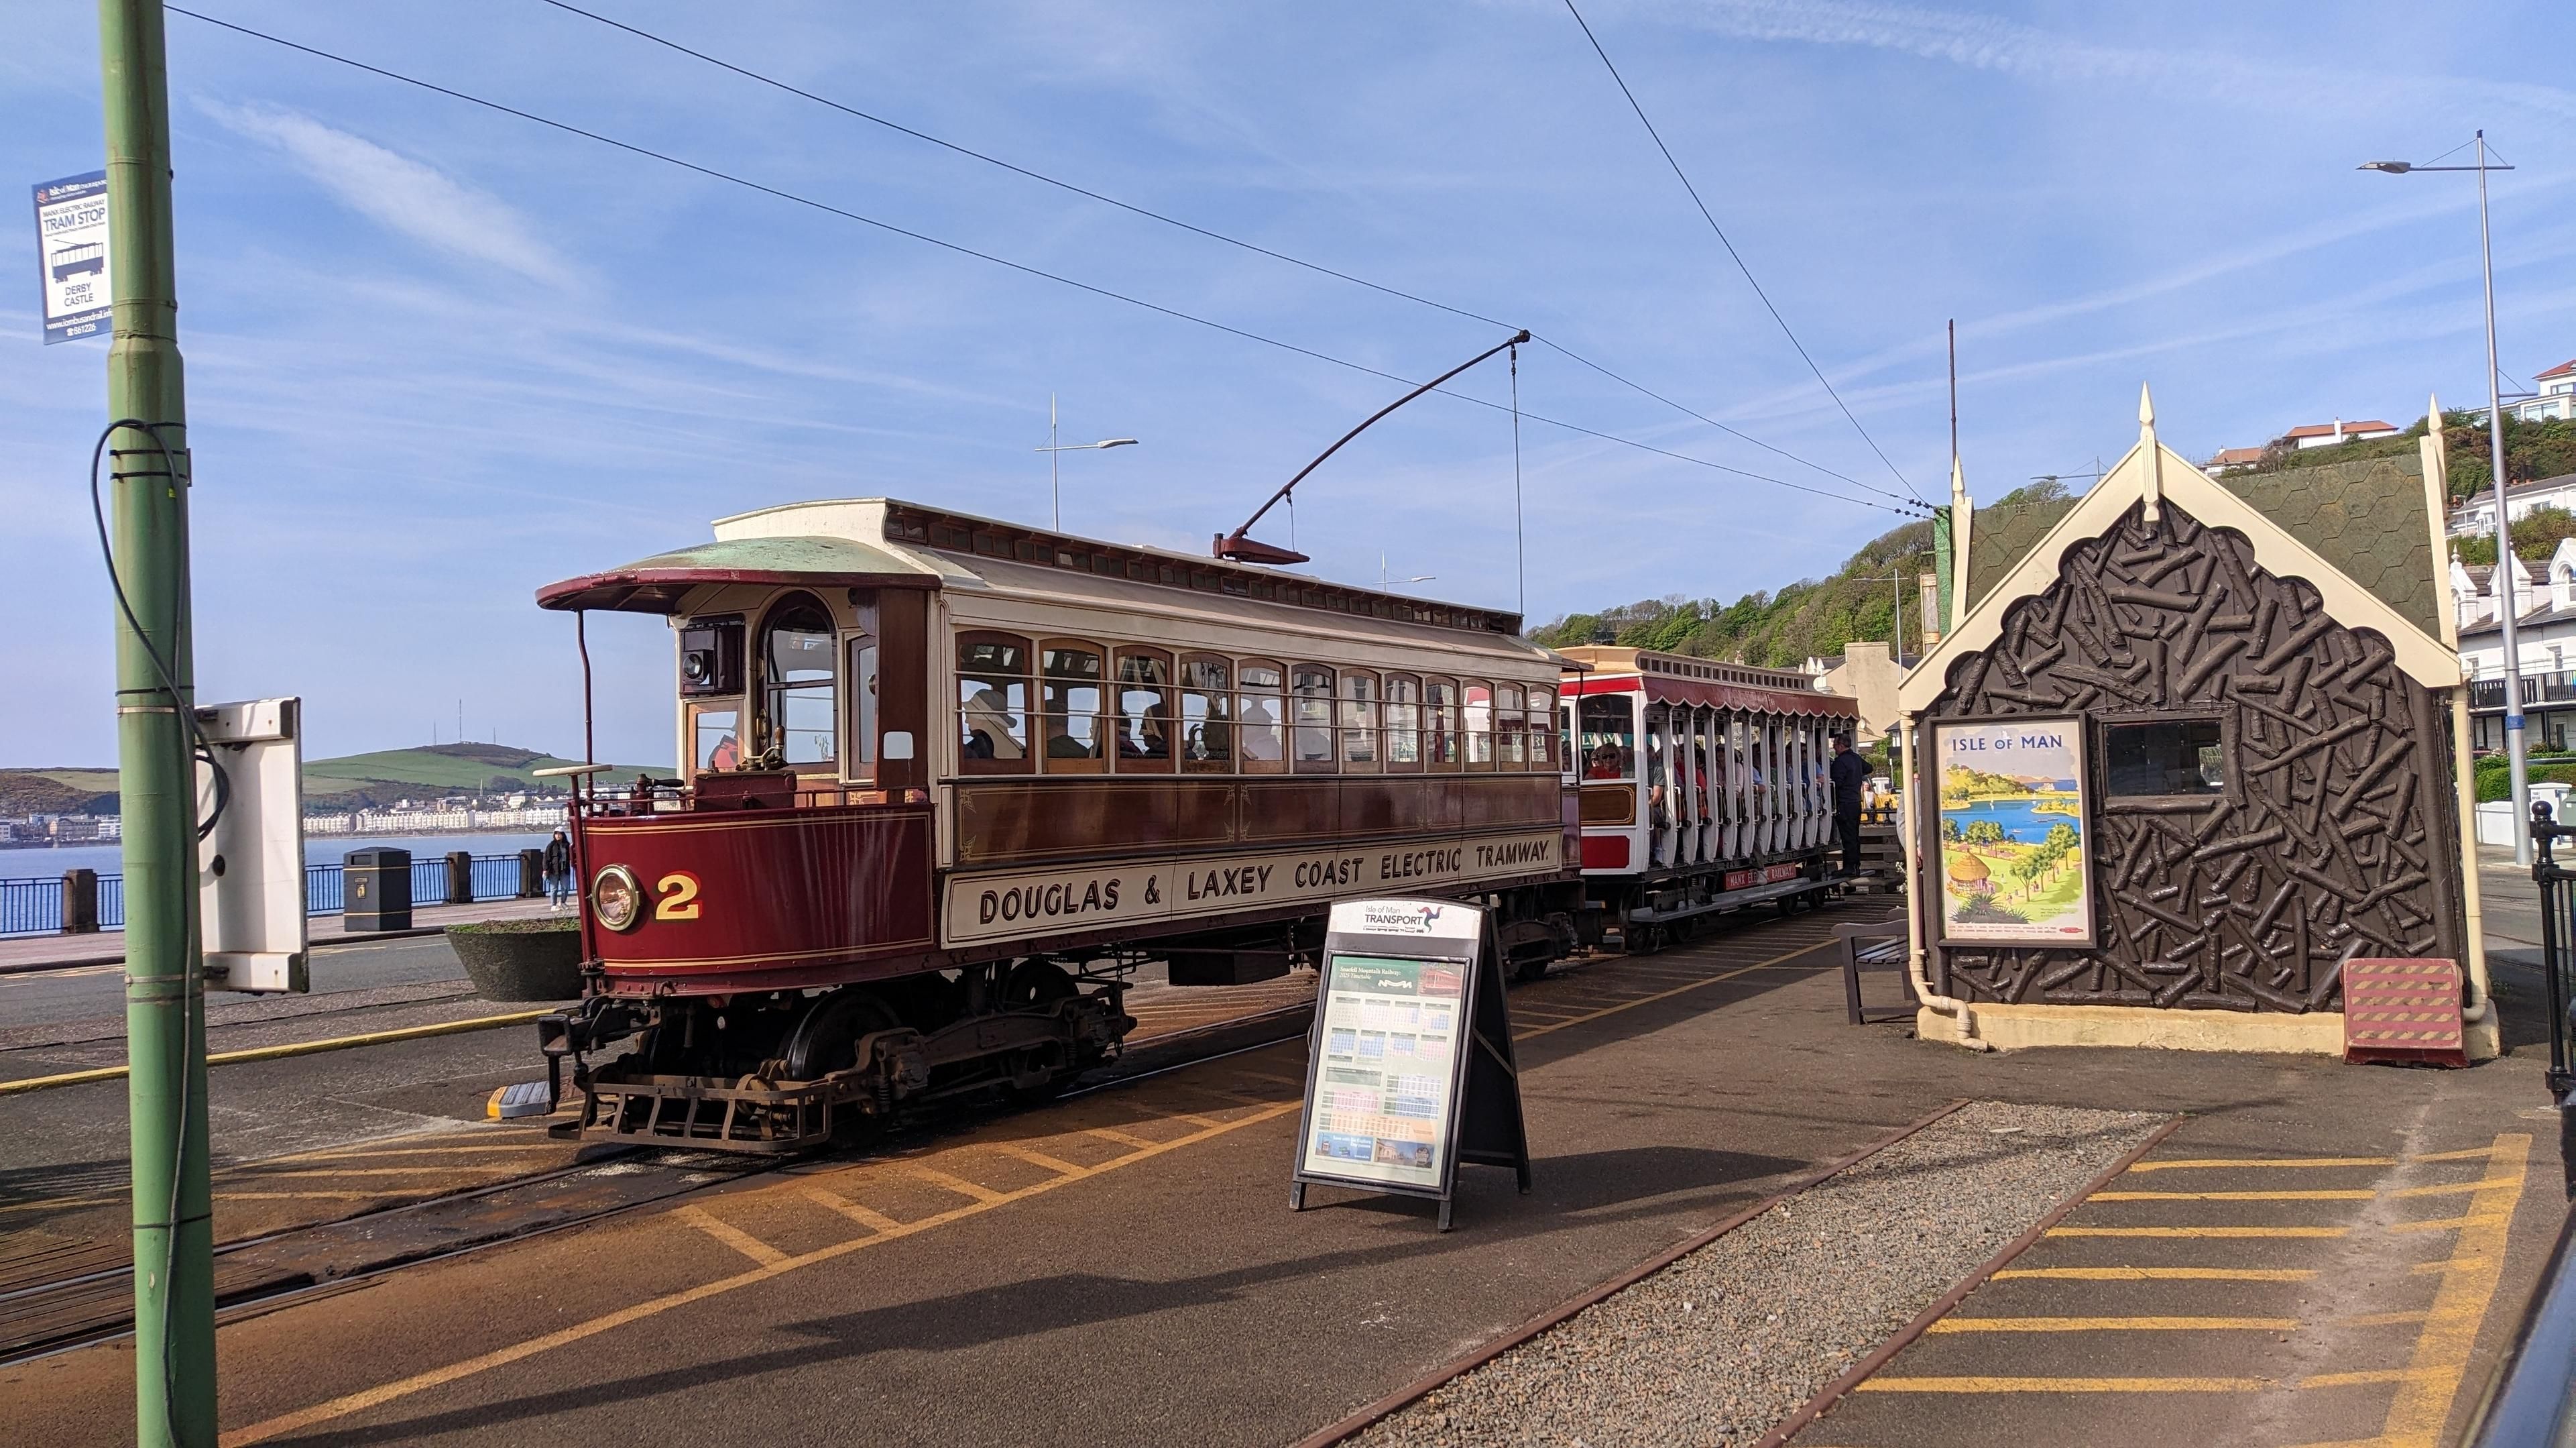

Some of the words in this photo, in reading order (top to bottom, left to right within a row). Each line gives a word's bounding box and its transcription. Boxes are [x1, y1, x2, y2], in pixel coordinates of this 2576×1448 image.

[43, 209, 58, 217] MANX
[59, 204, 83, 214] ELECTRIC
[83, 199, 105, 209] RAILWAY
[44, 213, 76, 231] TRAM
[78, 207, 105, 225] STOP
[65, 282, 91, 296] DERBY
[64, 293, 94, 307] CASTLE
[74, 323, 97, 335] 861226
[1952, 738, 1986, 751] ISLE
[1995, 739, 2012, 750] OF
[2021, 735, 2062, 748] MAN
[980, 878, 1121, 925] DOUGLAS
[1145, 875, 1161, 905] &
[1187, 864, 1274, 901] LAXEY
[1295, 857, 1364, 889] COAST
[1381, 848, 1462, 880] ELECTRIC
[1476, 840, 1549, 868] TRAMWAY.
[1731, 873, 1745, 886] MANX
[656, 873, 701, 920] 2
[1386, 906, 1401, 914] Man
[1365, 914, 1423, 925] TRANSPORT
